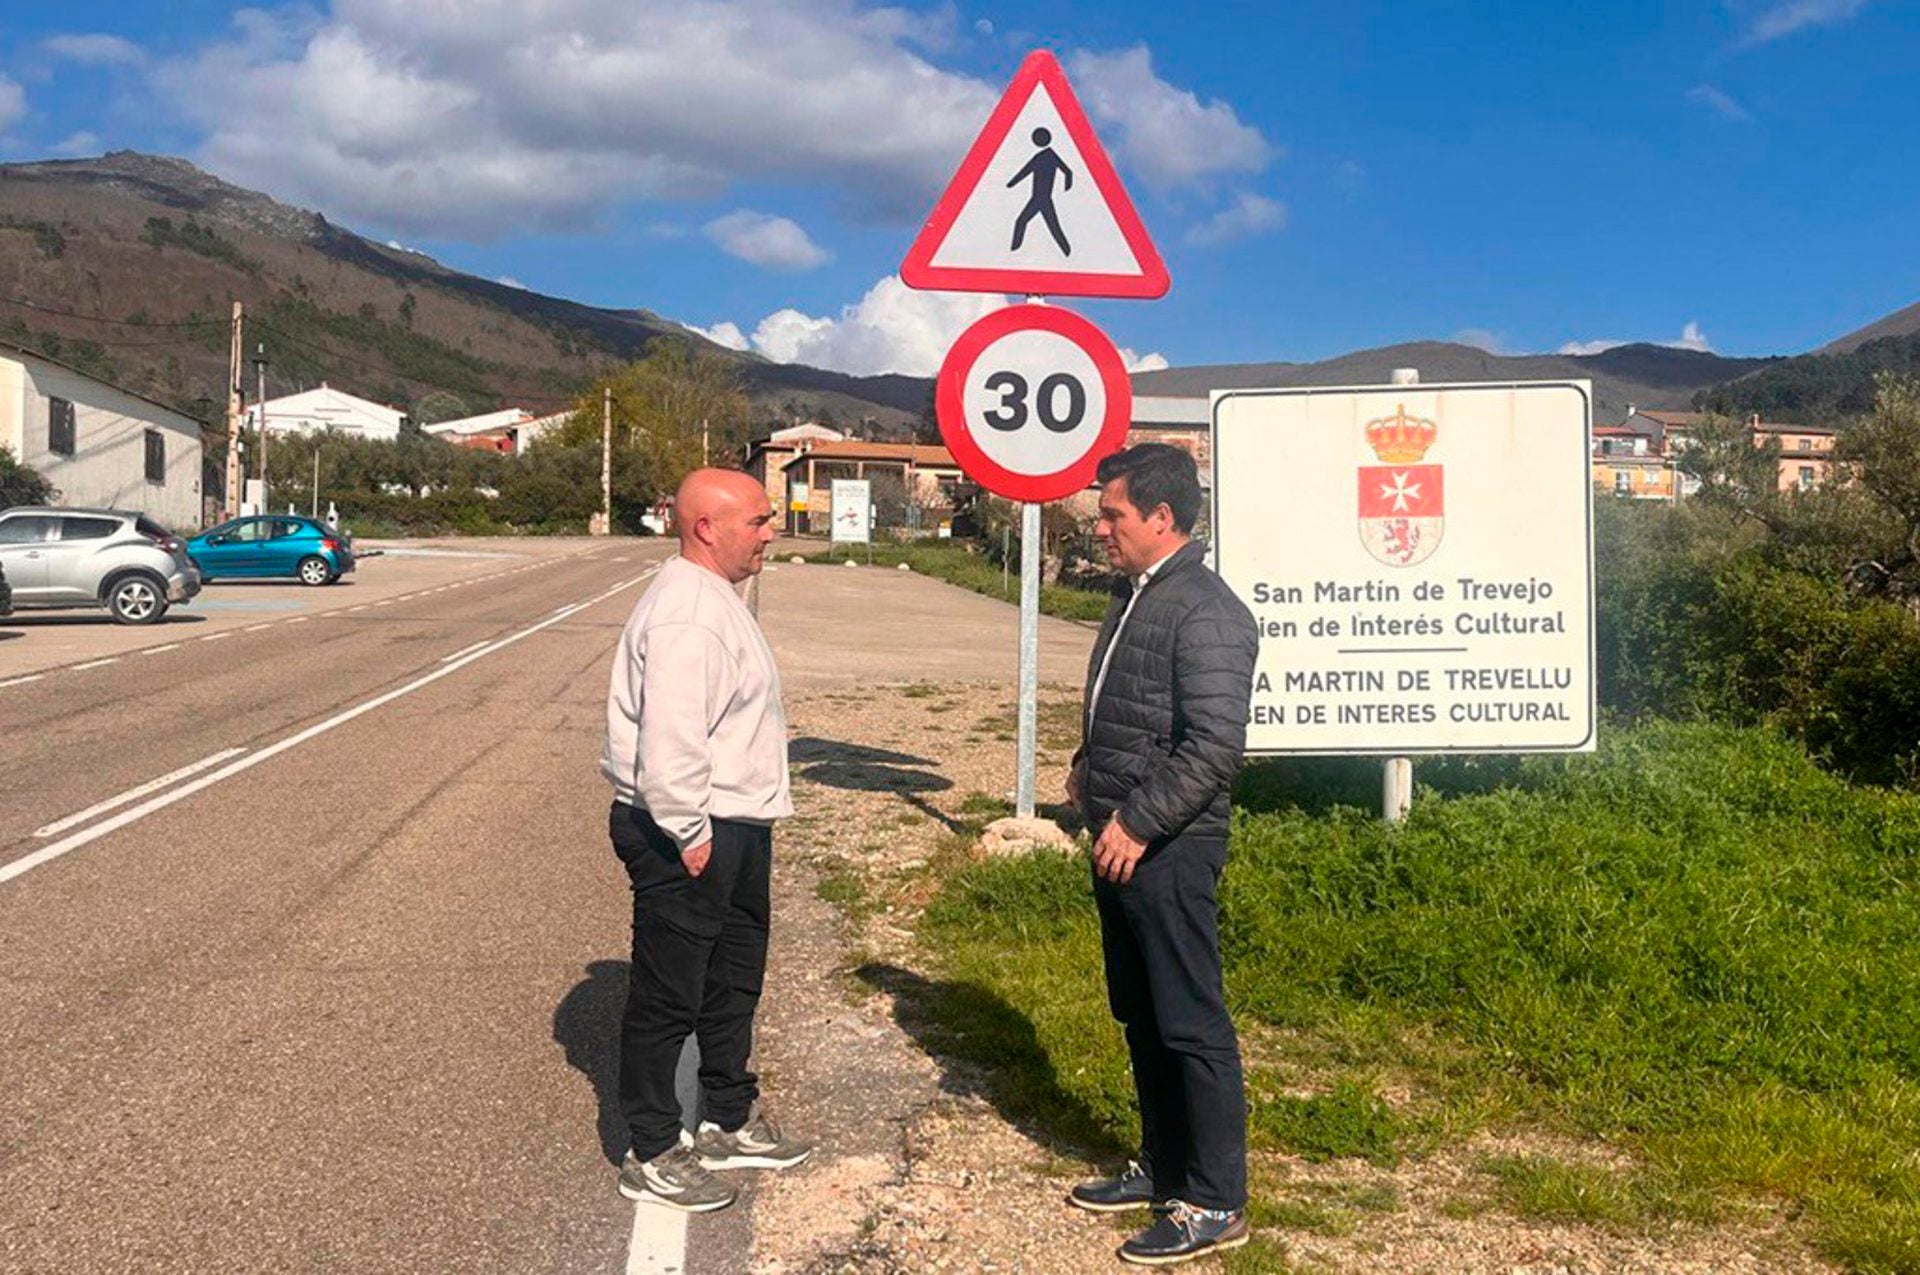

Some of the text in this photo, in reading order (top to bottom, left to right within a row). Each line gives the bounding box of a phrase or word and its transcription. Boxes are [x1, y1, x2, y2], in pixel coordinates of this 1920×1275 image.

[983, 371, 1086, 433] 30
[1253, 577, 1553, 605] San Martín de Trevejo
[1259, 611, 1565, 638] ien de Interés Cultural
[1253, 667, 1571, 693] A MARTIN DE TREVELLU
[1250, 702, 1570, 725] EN DE INTERES CULTURAL
